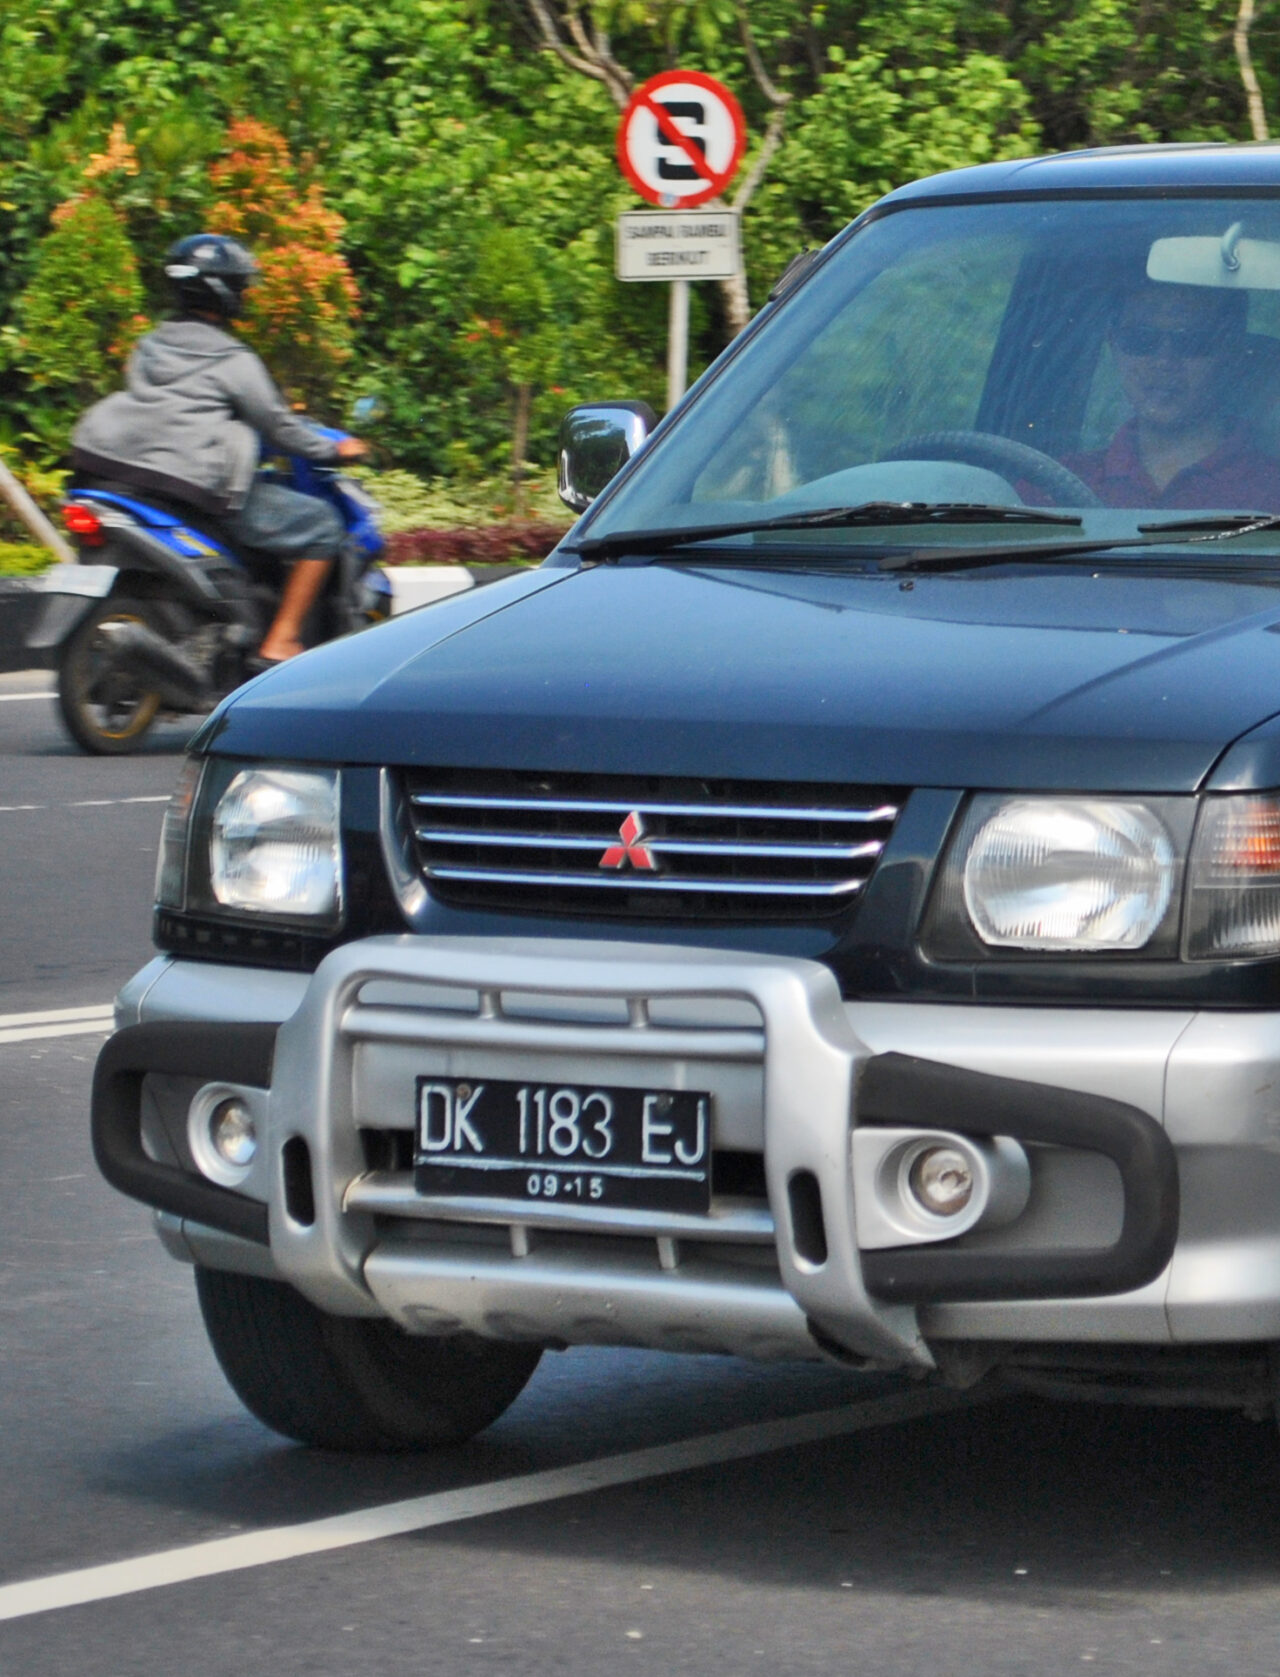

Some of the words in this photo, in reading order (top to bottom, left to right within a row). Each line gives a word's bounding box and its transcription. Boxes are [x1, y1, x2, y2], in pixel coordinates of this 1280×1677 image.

[420, 1084, 484, 1152] DK
[516, 1087, 613, 1159] 1183
[641, 1095, 706, 1165] EJ
